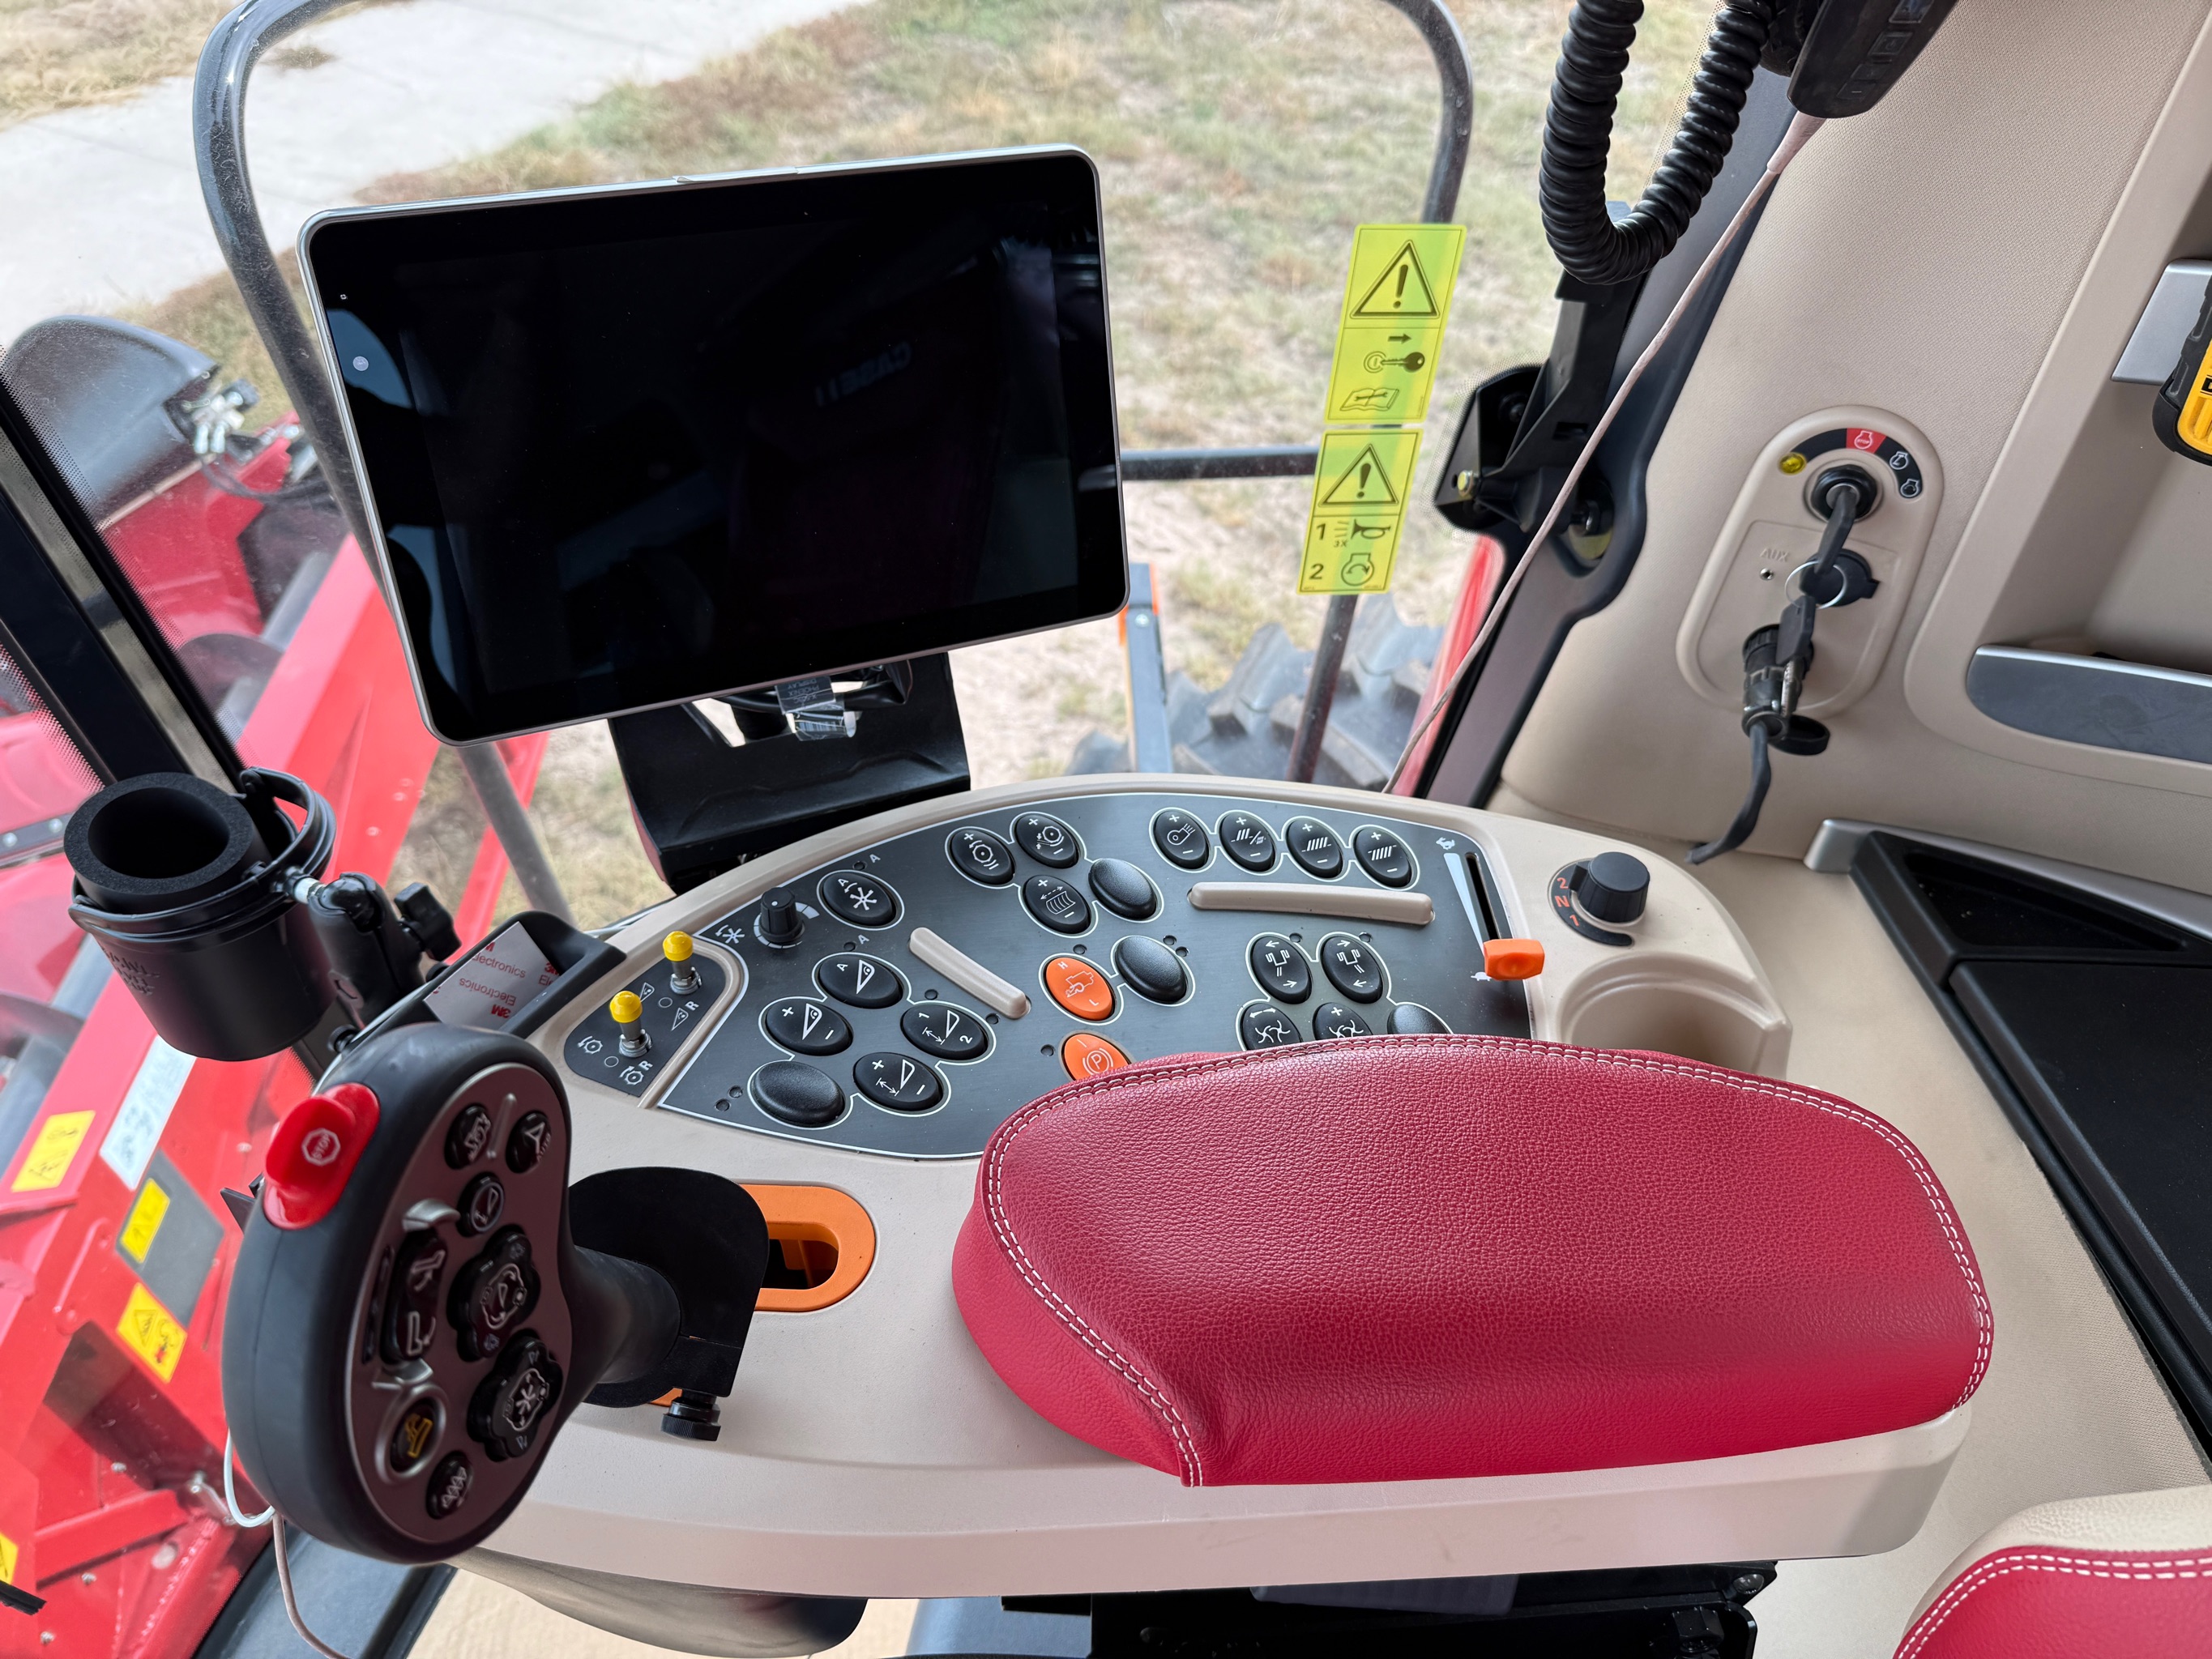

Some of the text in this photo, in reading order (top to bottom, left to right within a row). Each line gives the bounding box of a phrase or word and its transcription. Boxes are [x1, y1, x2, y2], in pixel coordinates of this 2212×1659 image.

[1316, 522, 1327, 540] 1
[1333, 539, 1348, 548] 3X
[1760, 548, 1788, 562] AUX
[1309, 564, 1325, 579] 2
[788, 678, 818, 689] DISPLAY
[869, 854, 882, 863] A
[837, 877, 849, 887] A
[1557, 877, 1568, 889] 2
[1555, 895, 1569, 907] N
[1570, 915, 1579, 926] 1
[858, 934, 870, 945] A
[836, 962, 848, 972] A
[1058, 961, 1068, 970] H
[459, 977, 517, 1006] Electronics
[685, 1000, 699, 1011] R
[491, 1004, 512, 1019] 3M
[918, 1012, 930, 1020] 1
[959, 1034, 973, 1044] 2
[638, 1060, 653, 1071] R
[1091, 1054, 1102, 1069] P
[310, 1133, 331, 1161] STOP
